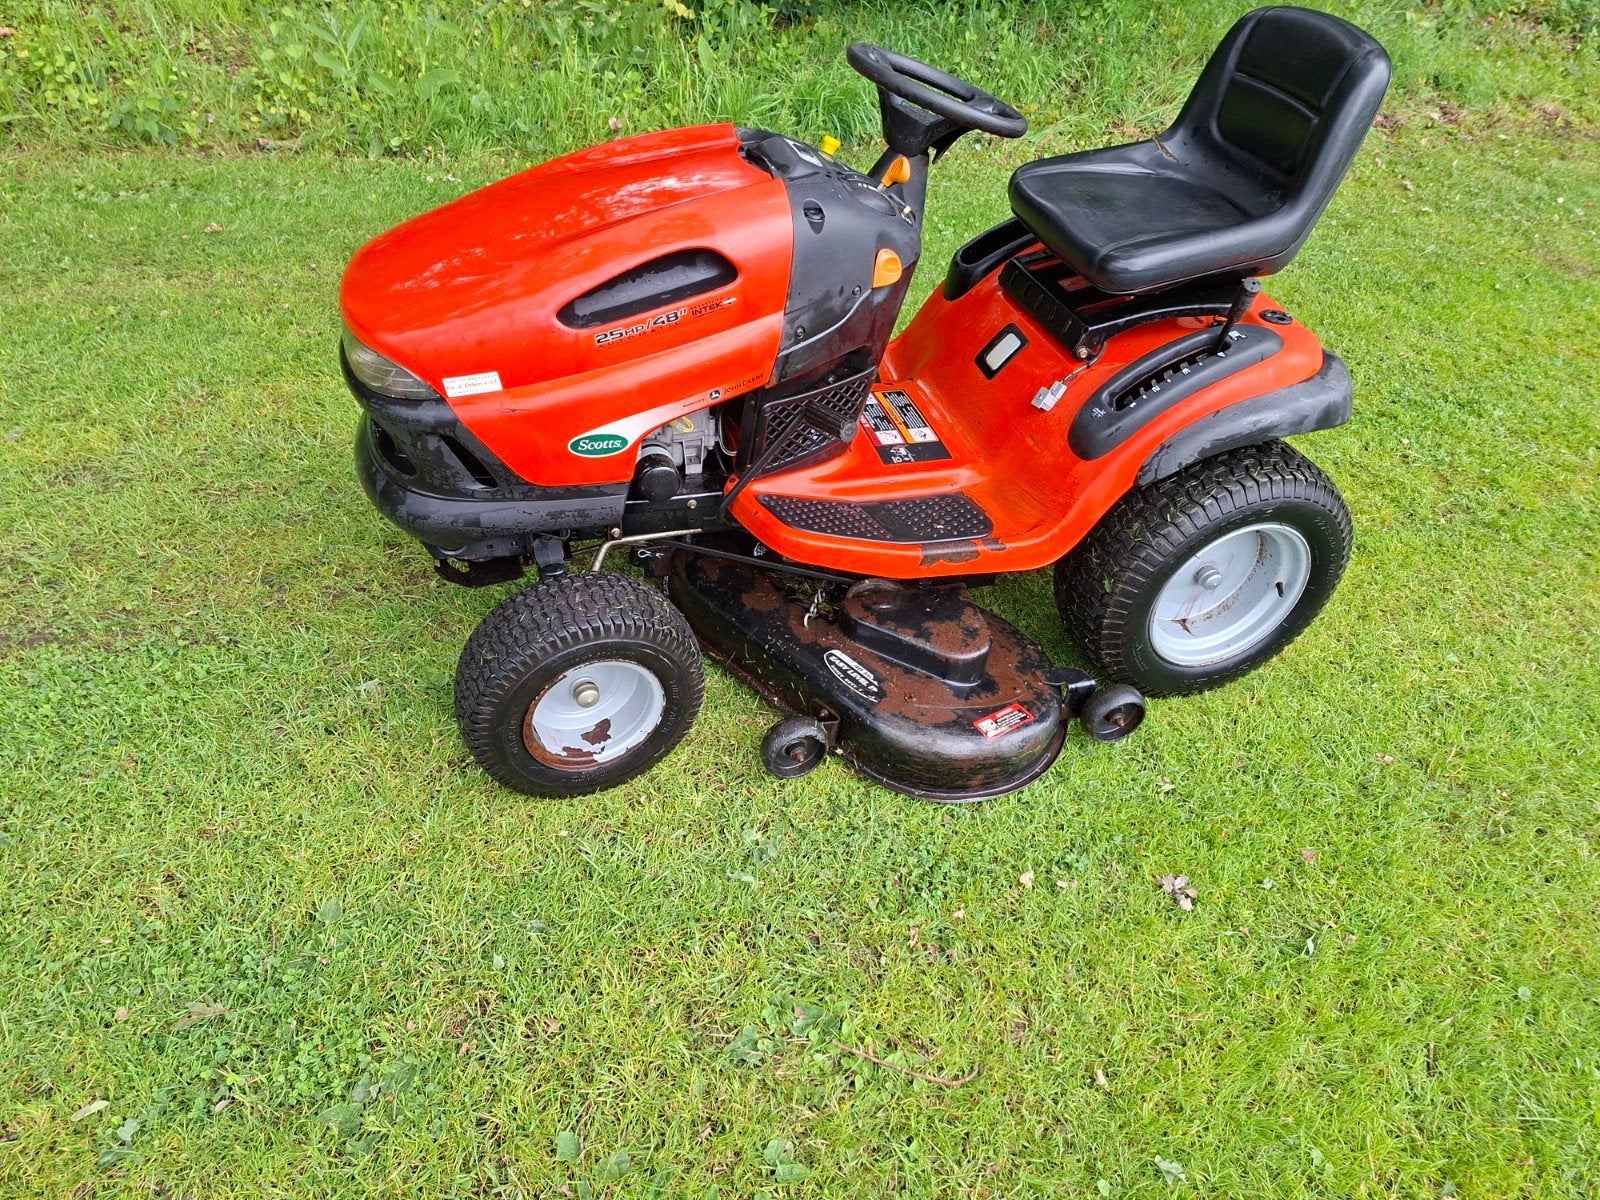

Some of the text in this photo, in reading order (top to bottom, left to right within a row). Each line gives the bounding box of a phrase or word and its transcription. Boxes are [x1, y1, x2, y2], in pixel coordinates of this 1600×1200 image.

[692, 301, 722, 316] INTEK
[598, 320, 682, 349] AUTOMATIC
[577, 439, 622, 451] Scotts
